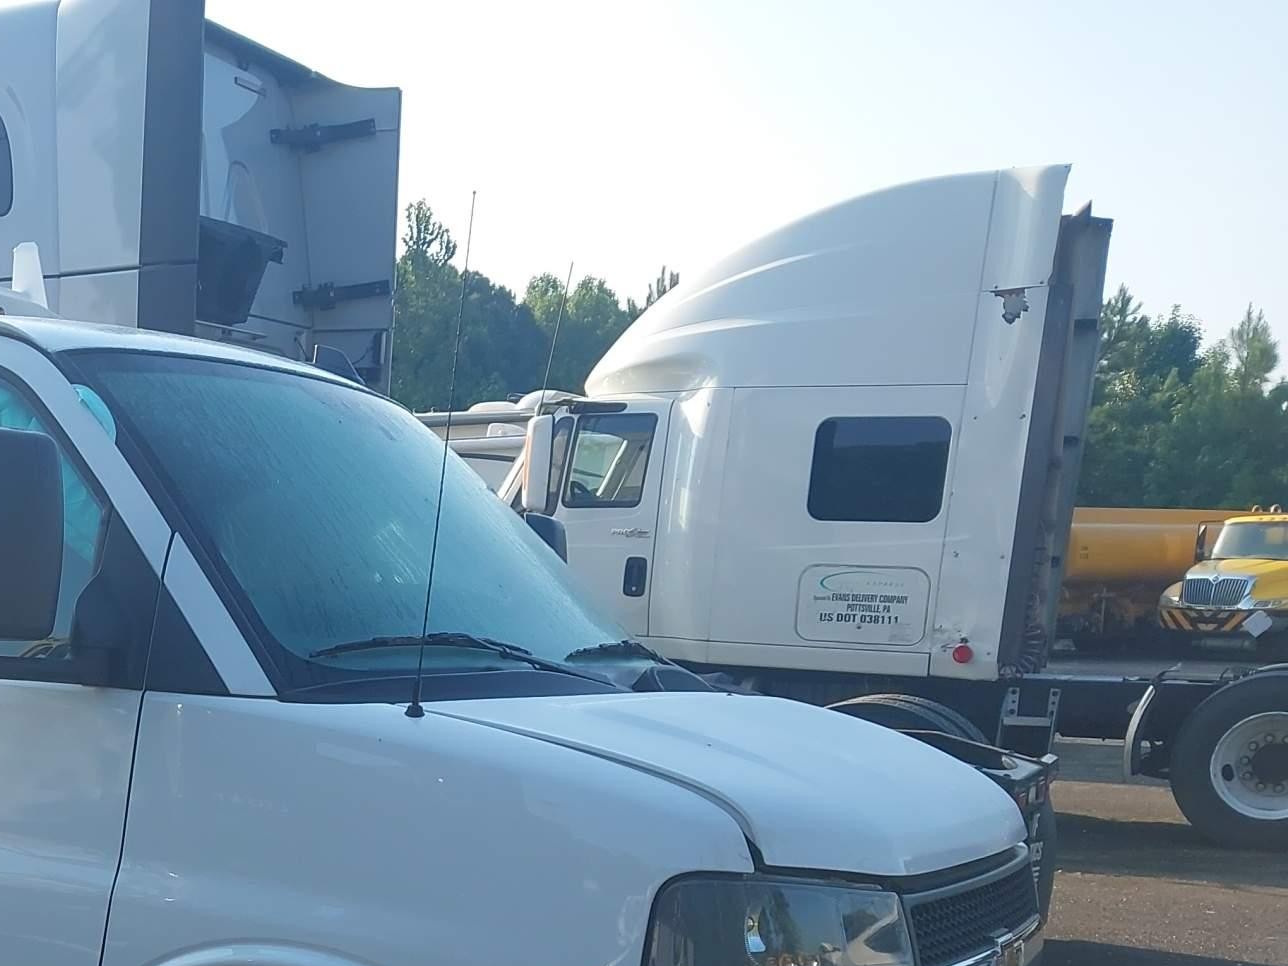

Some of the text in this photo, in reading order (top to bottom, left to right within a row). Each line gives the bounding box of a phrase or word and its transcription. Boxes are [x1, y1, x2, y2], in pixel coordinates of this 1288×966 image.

[851, 593, 878, 603] DELIVERY
[879, 595, 909, 604] COMPANY
[882, 604, 891, 613] PA
[819, 612, 899, 625] US DOT 038111
